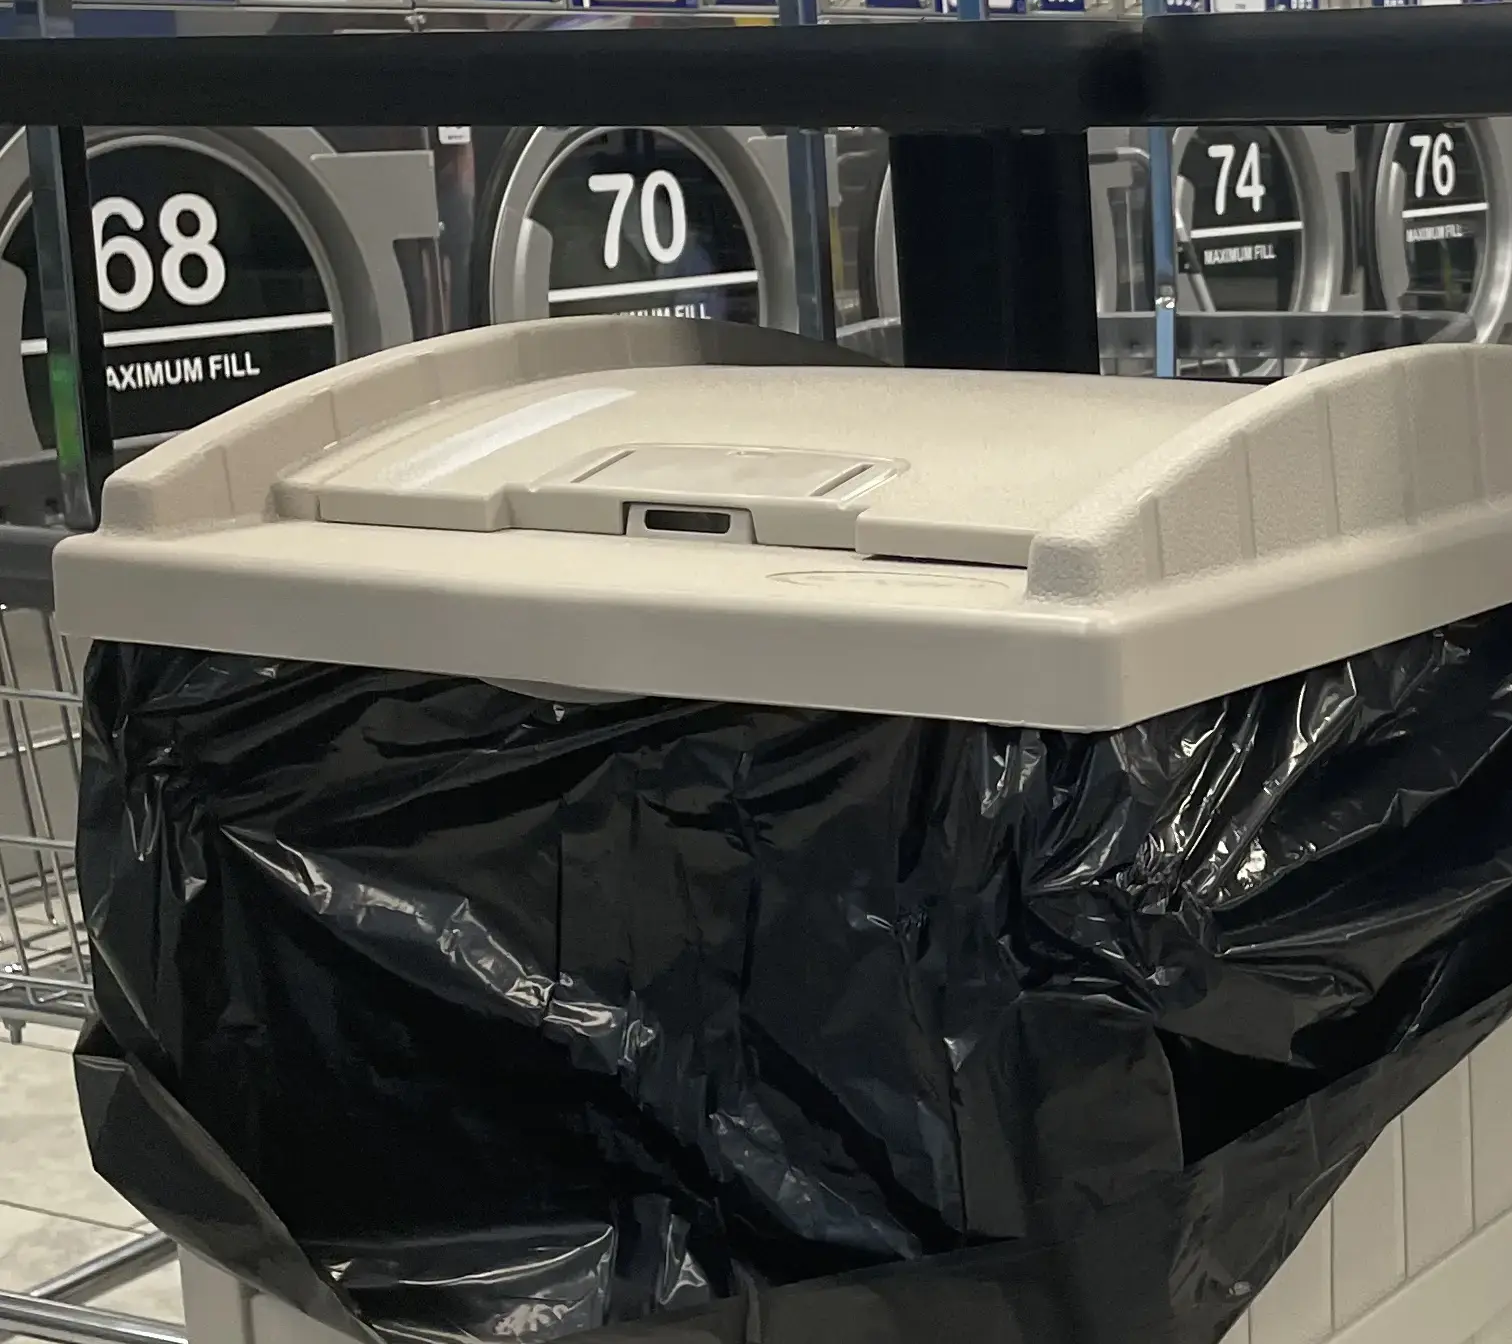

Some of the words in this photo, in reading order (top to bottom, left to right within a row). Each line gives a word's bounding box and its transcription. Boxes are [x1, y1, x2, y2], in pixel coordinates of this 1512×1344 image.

[1207, 141, 1266, 215] 74
[1409, 132, 1455, 198] 76
[92, 193, 226, 312] 68
[588, 170, 686, 268] 70
[1204, 246, 1253, 265] MAXIMUM
[1254, 244, 1277, 261] FILL
[106, 356, 203, 391] AXIMUM
[209, 352, 260, 379] FILL
